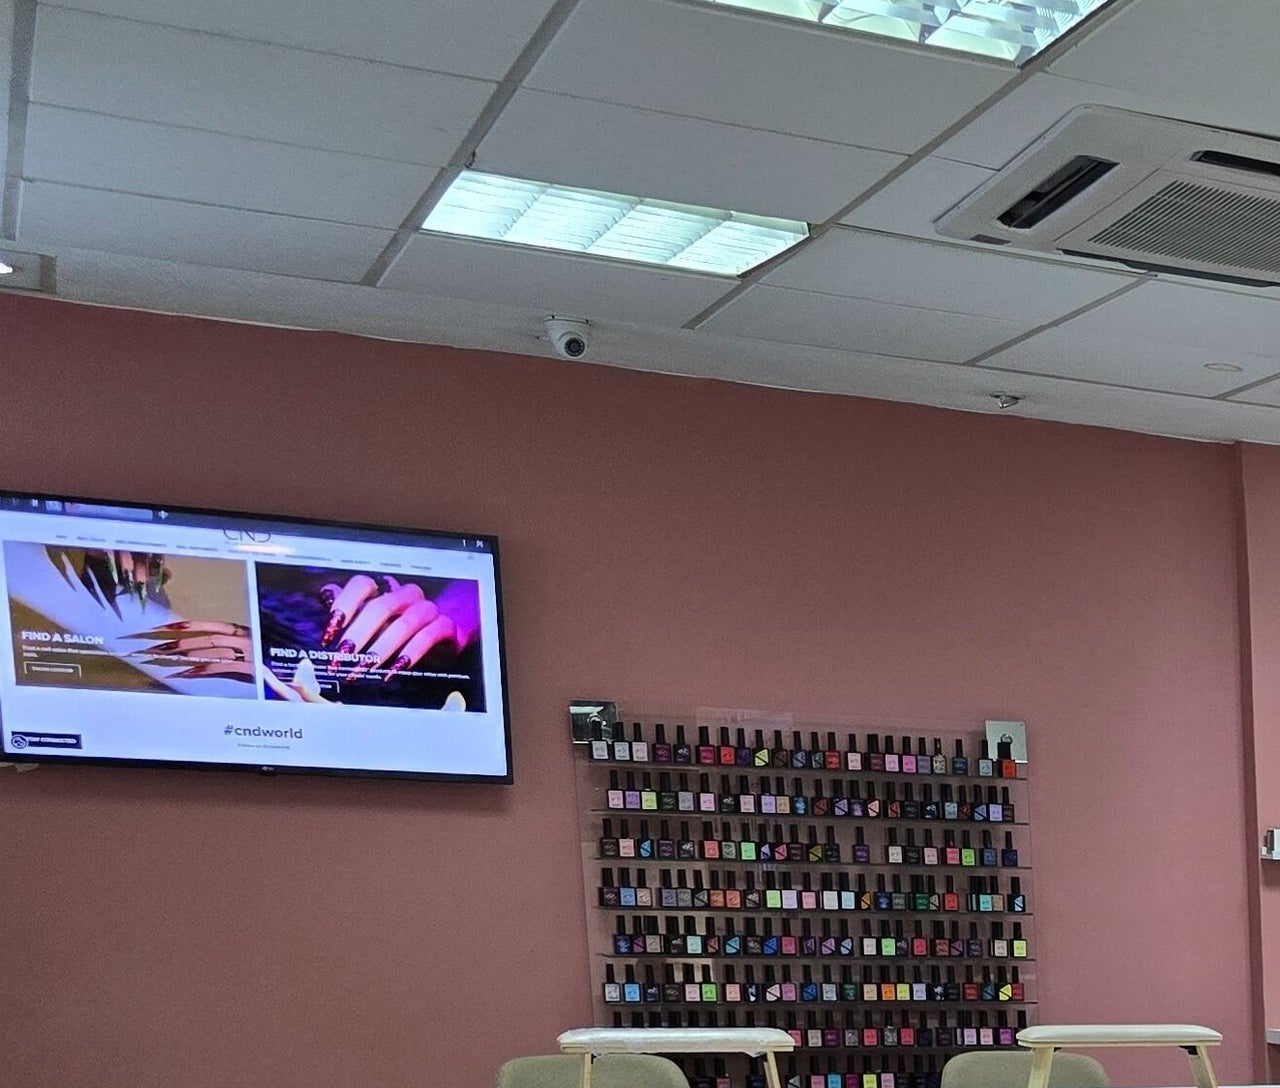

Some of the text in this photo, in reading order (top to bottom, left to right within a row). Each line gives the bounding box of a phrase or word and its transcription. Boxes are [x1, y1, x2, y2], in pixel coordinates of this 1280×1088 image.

[21, 630, 104, 646] FIND A SALON
[270, 647, 297, 659] FIND
[309, 650, 381, 664] DISTRIBUTOR
[223, 724, 304, 740] #cndworld
